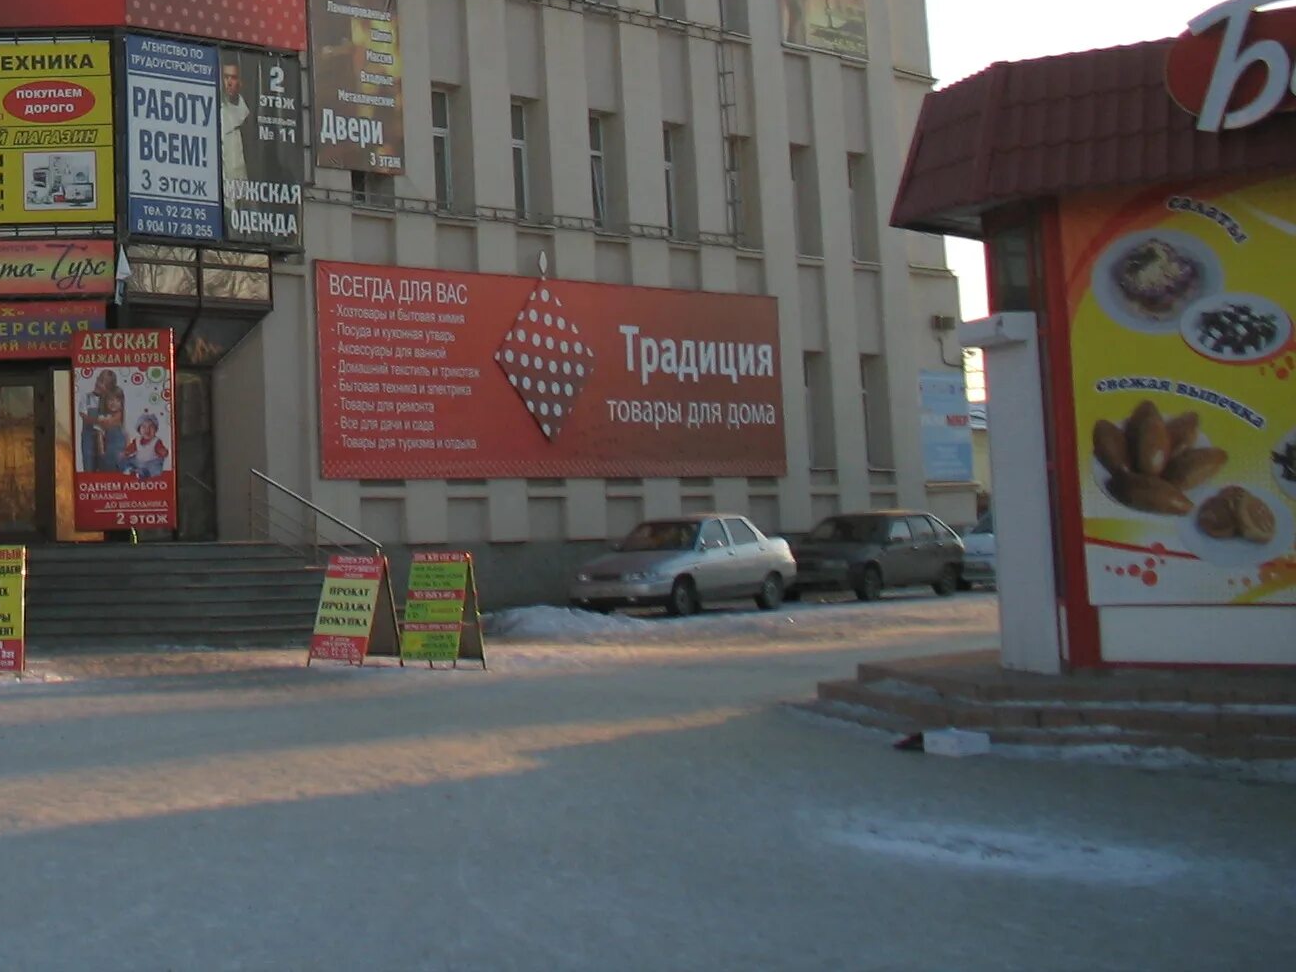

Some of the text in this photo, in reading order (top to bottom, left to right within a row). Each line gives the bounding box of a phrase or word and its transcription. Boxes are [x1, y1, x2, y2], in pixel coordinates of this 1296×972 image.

[141, 40, 204, 59] АГЕНТСТВО ПО
[131, 53, 213, 75] ТРУДОУСТРОЙСТВУ
[269, 66, 285, 93] 2
[15, 88, 83, 100] ПОКУПАЕМ
[259, 94, 296, 110] этаж
[24, 103, 75, 115] ДОРОГО
[132, 86, 214, 128] РАБОТУ
[12, 128, 99, 146] МАГАЗИН
[259, 126, 296, 143] № 11
[320, 109, 384, 148] Двери
[139, 129, 208, 168] ВСЕМ!
[370, 153, 377, 166] 3
[141, 169, 207, 197] 3 этаж
[223, 178, 302, 205] МУЖСКАЯ
[143, 204, 163, 217] тел.
[165, 204, 179, 218] 92
[179, 206, 193, 219] 22
[1167, 196, 1248, 244] салаты
[137, 218, 144, 231] 8
[167, 221, 178, 234] 17
[180, 222, 193, 235] 28
[230, 208, 299, 237] ОДЕЖДА
[329, 274, 468, 305] ВСЕГДА ДЛЯ ВАС
[336, 304, 387, 322] Хозтовары
[389, 310, 395, 320] и
[397, 308, 435, 322] бытовая
[81, 332, 159, 350] ДЕТСКАЯ
[336, 322, 455, 344] Посуда и кухонная утварь
[78, 353, 167, 364] ОДЕЖДА И ОБУВЬ
[338, 341, 446, 359] Аксессуары для ванной
[619, 325, 774, 385] Традиция
[339, 359, 389, 376] Домашний
[391, 364, 431, 377] текстиль
[339, 378, 380, 394] Бытовая
[381, 383, 417, 395] техника
[427, 385, 472, 399] электрика
[340, 397, 435, 416] Товары для ремонта
[1096, 378, 1265, 428] свежая выпечка
[606, 399, 776, 430] товары для дома
[360, 419, 378, 431] для
[342, 434, 376, 451] Товары
[378, 438, 396, 450] для
[398, 438, 435, 452] туризма
[444, 439, 478, 450] отдыха
[79, 482, 168, 493] ОДЕНЕМ ЛЮБОГО
[90, 492, 128, 500] МАЛЫША
[105, 500, 168, 509] ДО ШКОЛЬНИКА
[116, 512, 168, 525] 2 этаж
[329, 587, 370, 597] ПРОКАТ
[321, 601, 371, 612] ПРОДАЖА
[319, 616, 367, 627] ПОКУПКА
